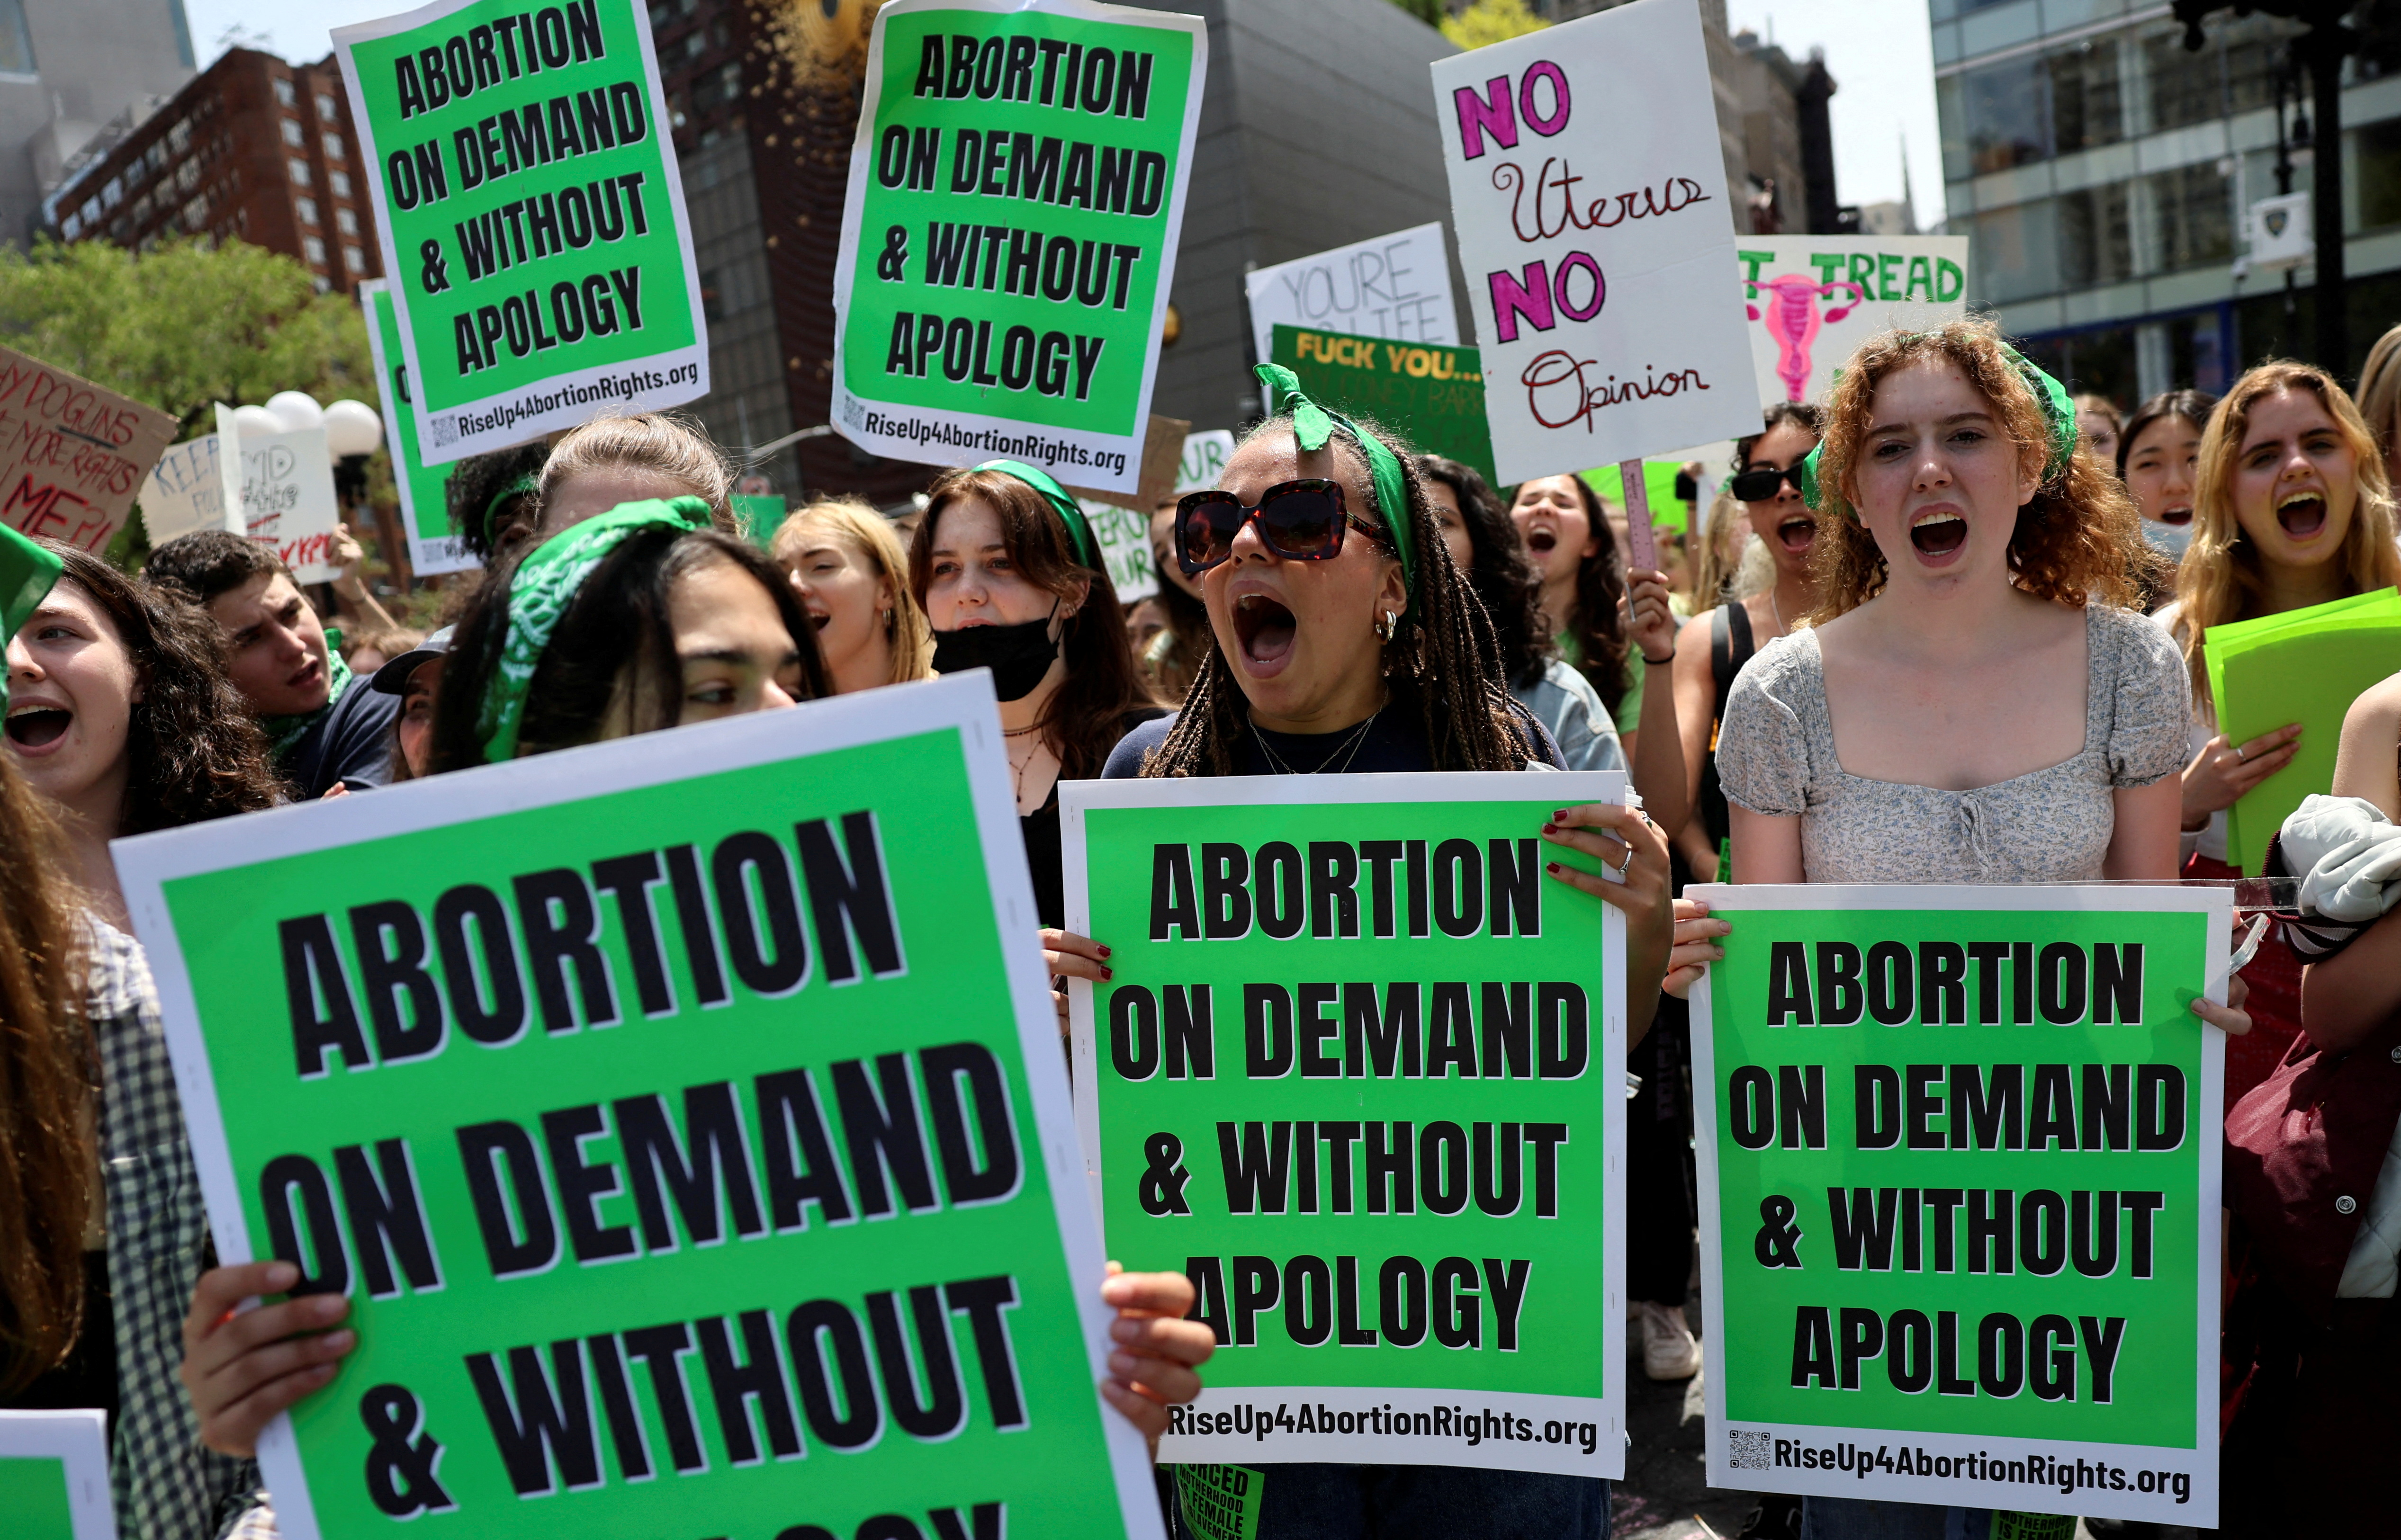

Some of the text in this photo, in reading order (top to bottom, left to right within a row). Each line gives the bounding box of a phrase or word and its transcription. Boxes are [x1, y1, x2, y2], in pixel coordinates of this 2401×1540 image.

[392, 0, 607, 121] ABORTION
[914, 35, 1152, 118] ABORTION
[388, 80, 650, 209] ON DEMAND
[1453, 60, 1571, 161] NO
[879, 125, 1165, 215] ON DEMAND
[1493, 157, 1712, 242] Uterus
[421, 170, 650, 293] & WITHOUT
[878, 222, 1140, 309] & WITHOUT
[453, 263, 645, 377] APOLOGY
[1488, 251, 1606, 344] NO
[1811, 252, 1964, 303] TREAD
[886, 312, 1104, 399] APOLOGY
[1296, 332, 1376, 369] FUCK
[1521, 350, 1710, 433] Opinion
[458, 361, 699, 438] RiseUp4AbortionRights.org
[863, 410, 1126, 476] RiseUp4AbortionRights.org
[1150, 839, 1538, 939] ABORTION
[279, 811, 899, 1074] ABORTION
[1767, 941, 2142, 1025] ABORTION
[1109, 984, 1213, 1079] ON
[1243, 982, 1587, 1077] DEMAND
[1729, 1065, 1825, 1148] ON
[1855, 1064, 2185, 1149] DEMAND
[256, 1043, 1016, 1300] ON DEMAND
[1139, 1121, 1566, 1216] & WITHOUT
[1755, 1187, 2162, 1277] & WITHOUT
[1183, 1253, 1535, 1352] APOLOGY
[360, 1275, 1022, 1515] & WITHOUT
[1791, 1306, 2125, 1402] APOLOGY
[1167, 1403, 1597, 1454] RiseUp4AbortionRights.org
[1773, 1438, 2191, 1504] RiseUp4AbortionRights.org
[1192, 1490, 1244, 1534] FEMALE
[1999, 1521, 2012, 1539] IS
